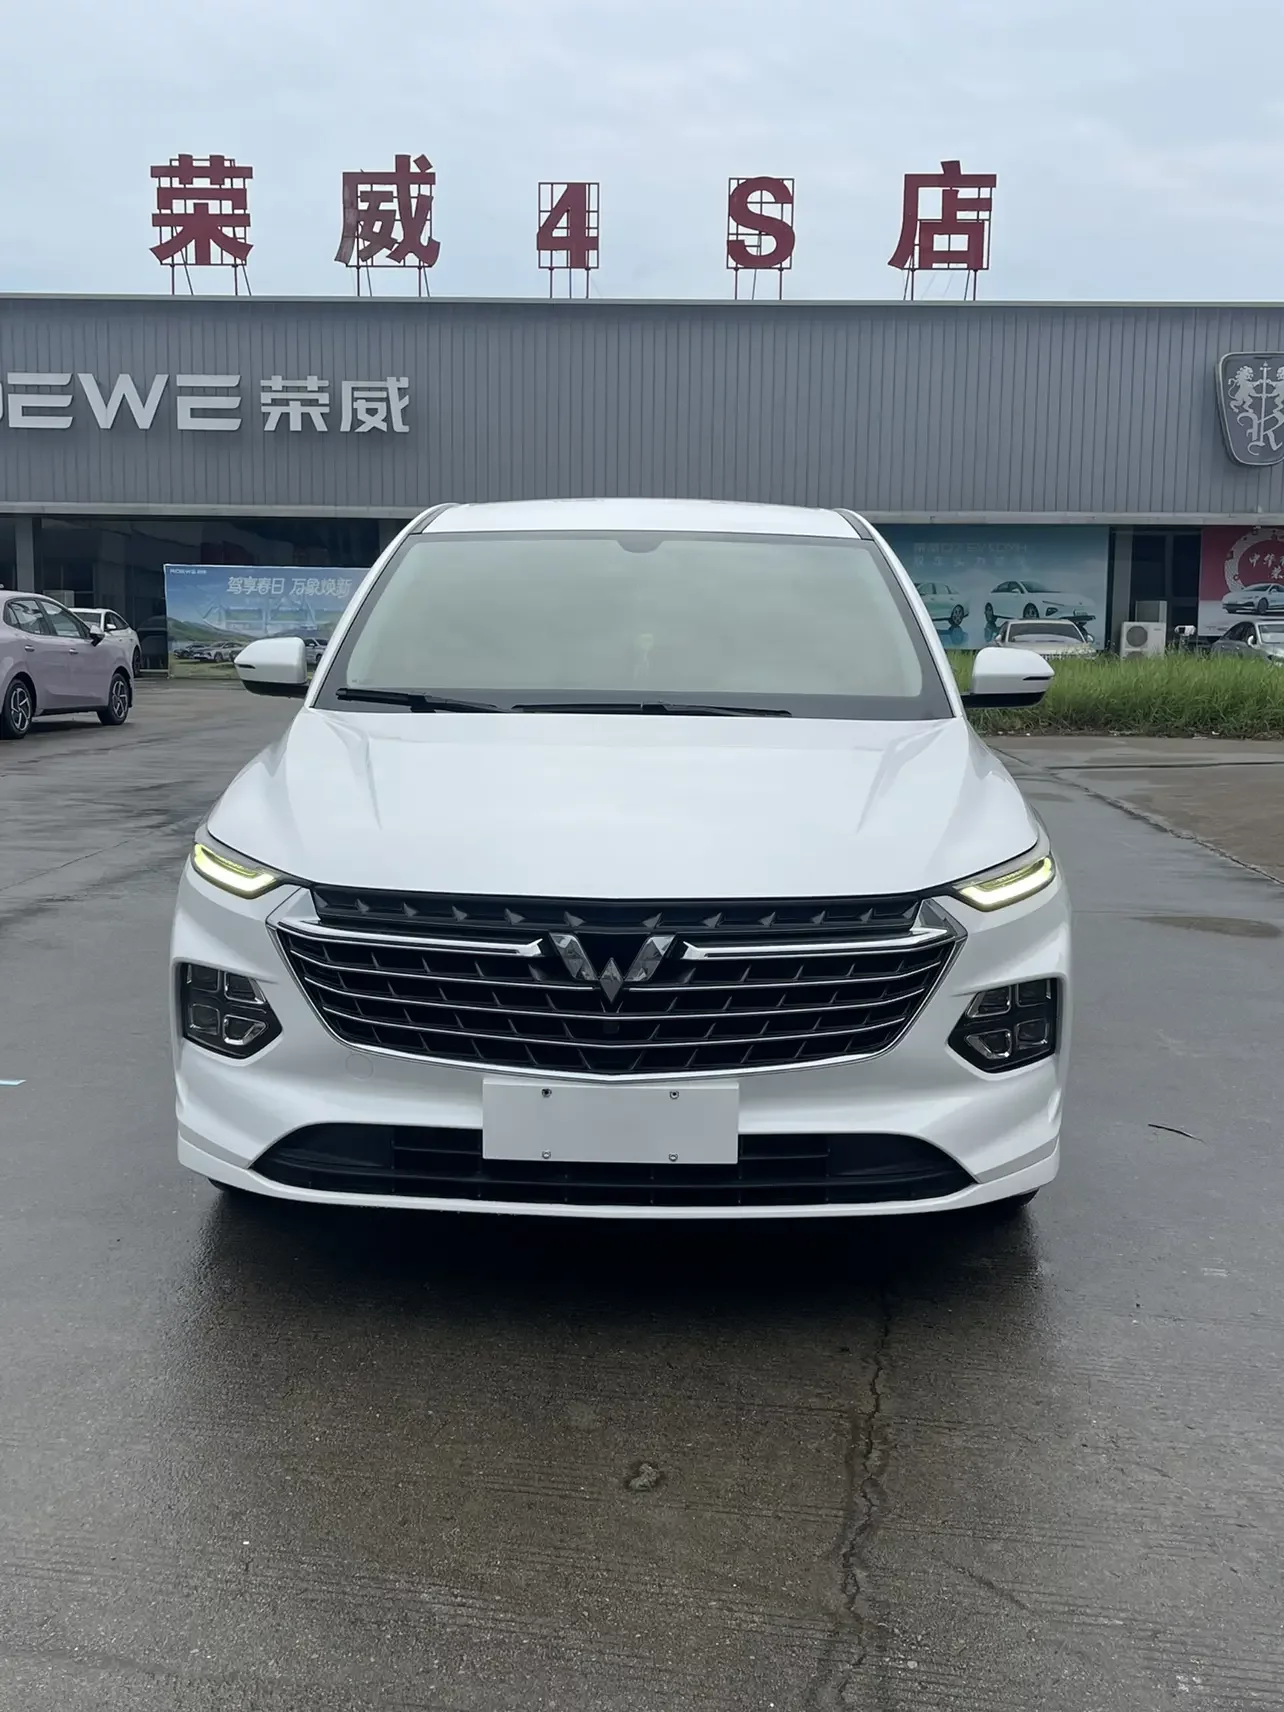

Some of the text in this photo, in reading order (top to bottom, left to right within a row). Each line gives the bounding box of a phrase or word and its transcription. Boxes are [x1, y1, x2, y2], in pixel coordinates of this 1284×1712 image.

[150, 153, 998, 270] 荣威4S店
[0, 371, 410, 433] EWE 荣威
[227, 576, 353, 598] 驾享春日 万象焕新
